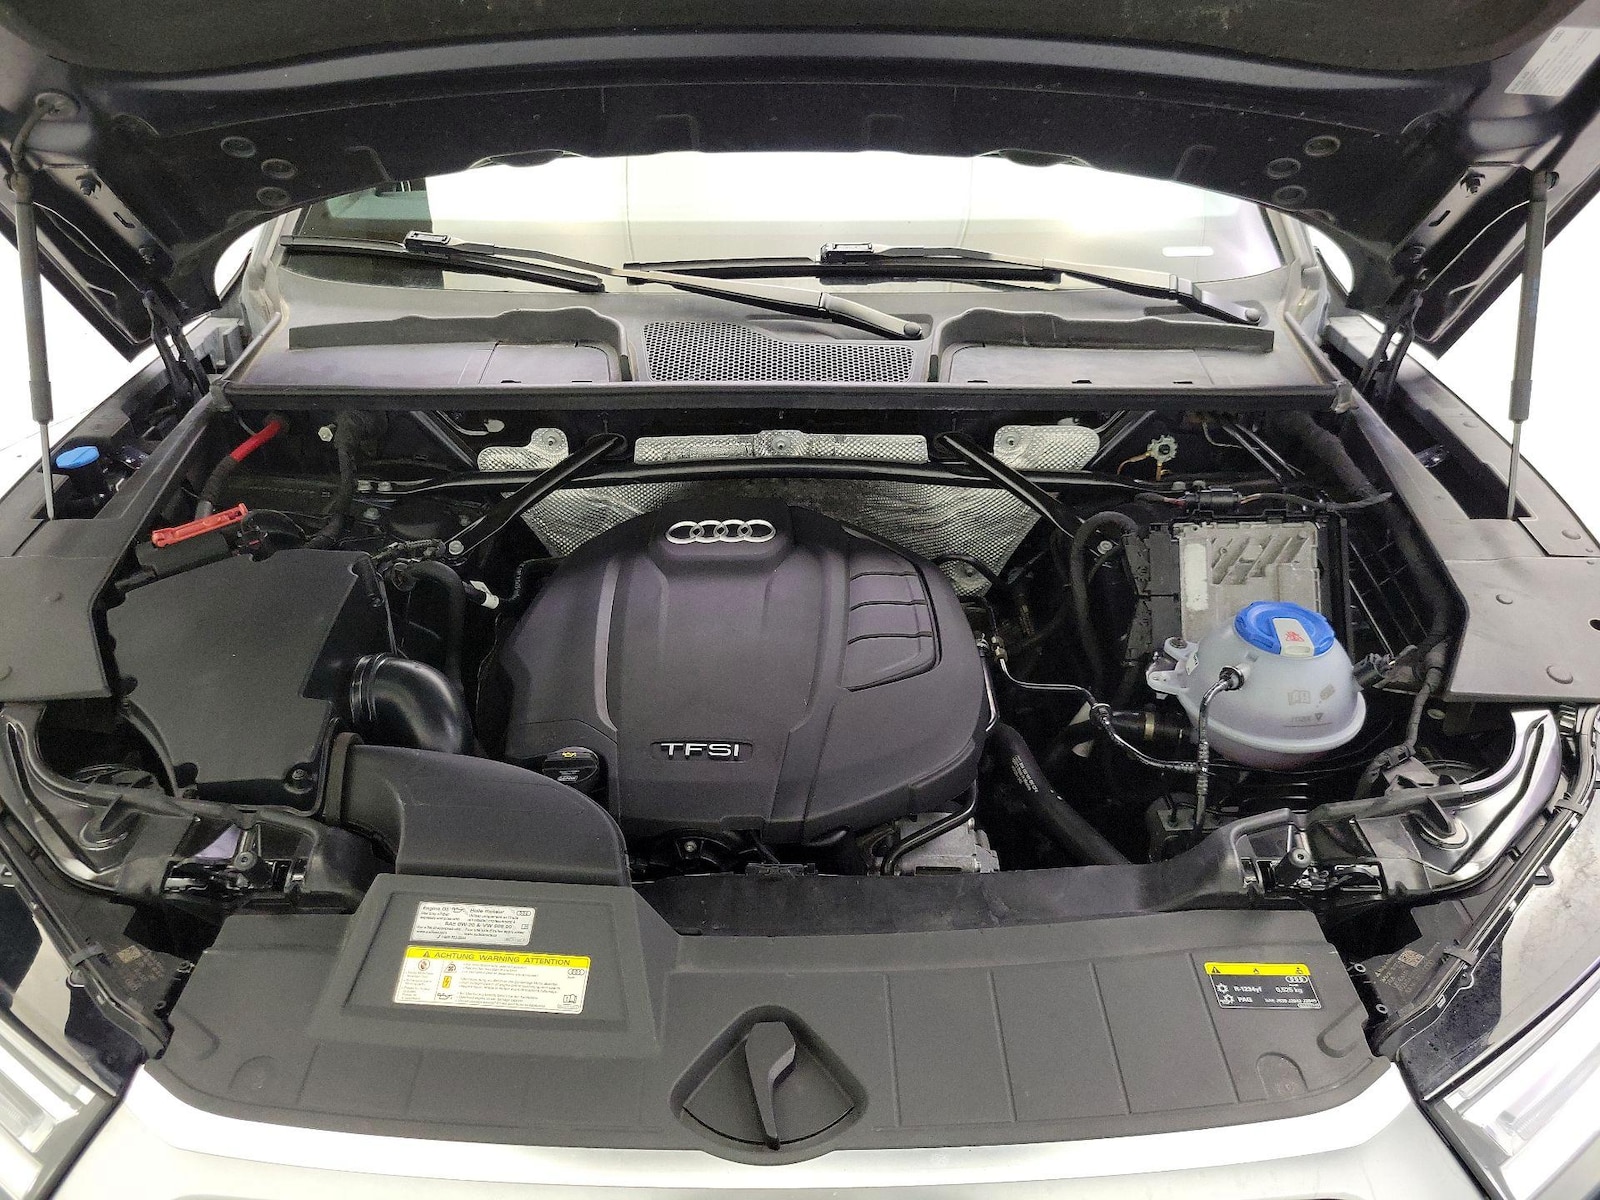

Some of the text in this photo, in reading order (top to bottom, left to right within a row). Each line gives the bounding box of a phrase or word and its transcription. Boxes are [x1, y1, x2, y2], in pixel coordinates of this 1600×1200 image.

[660, 743, 740, 757] TFSI
[434, 951, 571, 966] ACHTUNG WARNING ATTENTION
[1233, 985, 1263, 994] R-1234yf
[1294, 986, 1304, 994] kg
